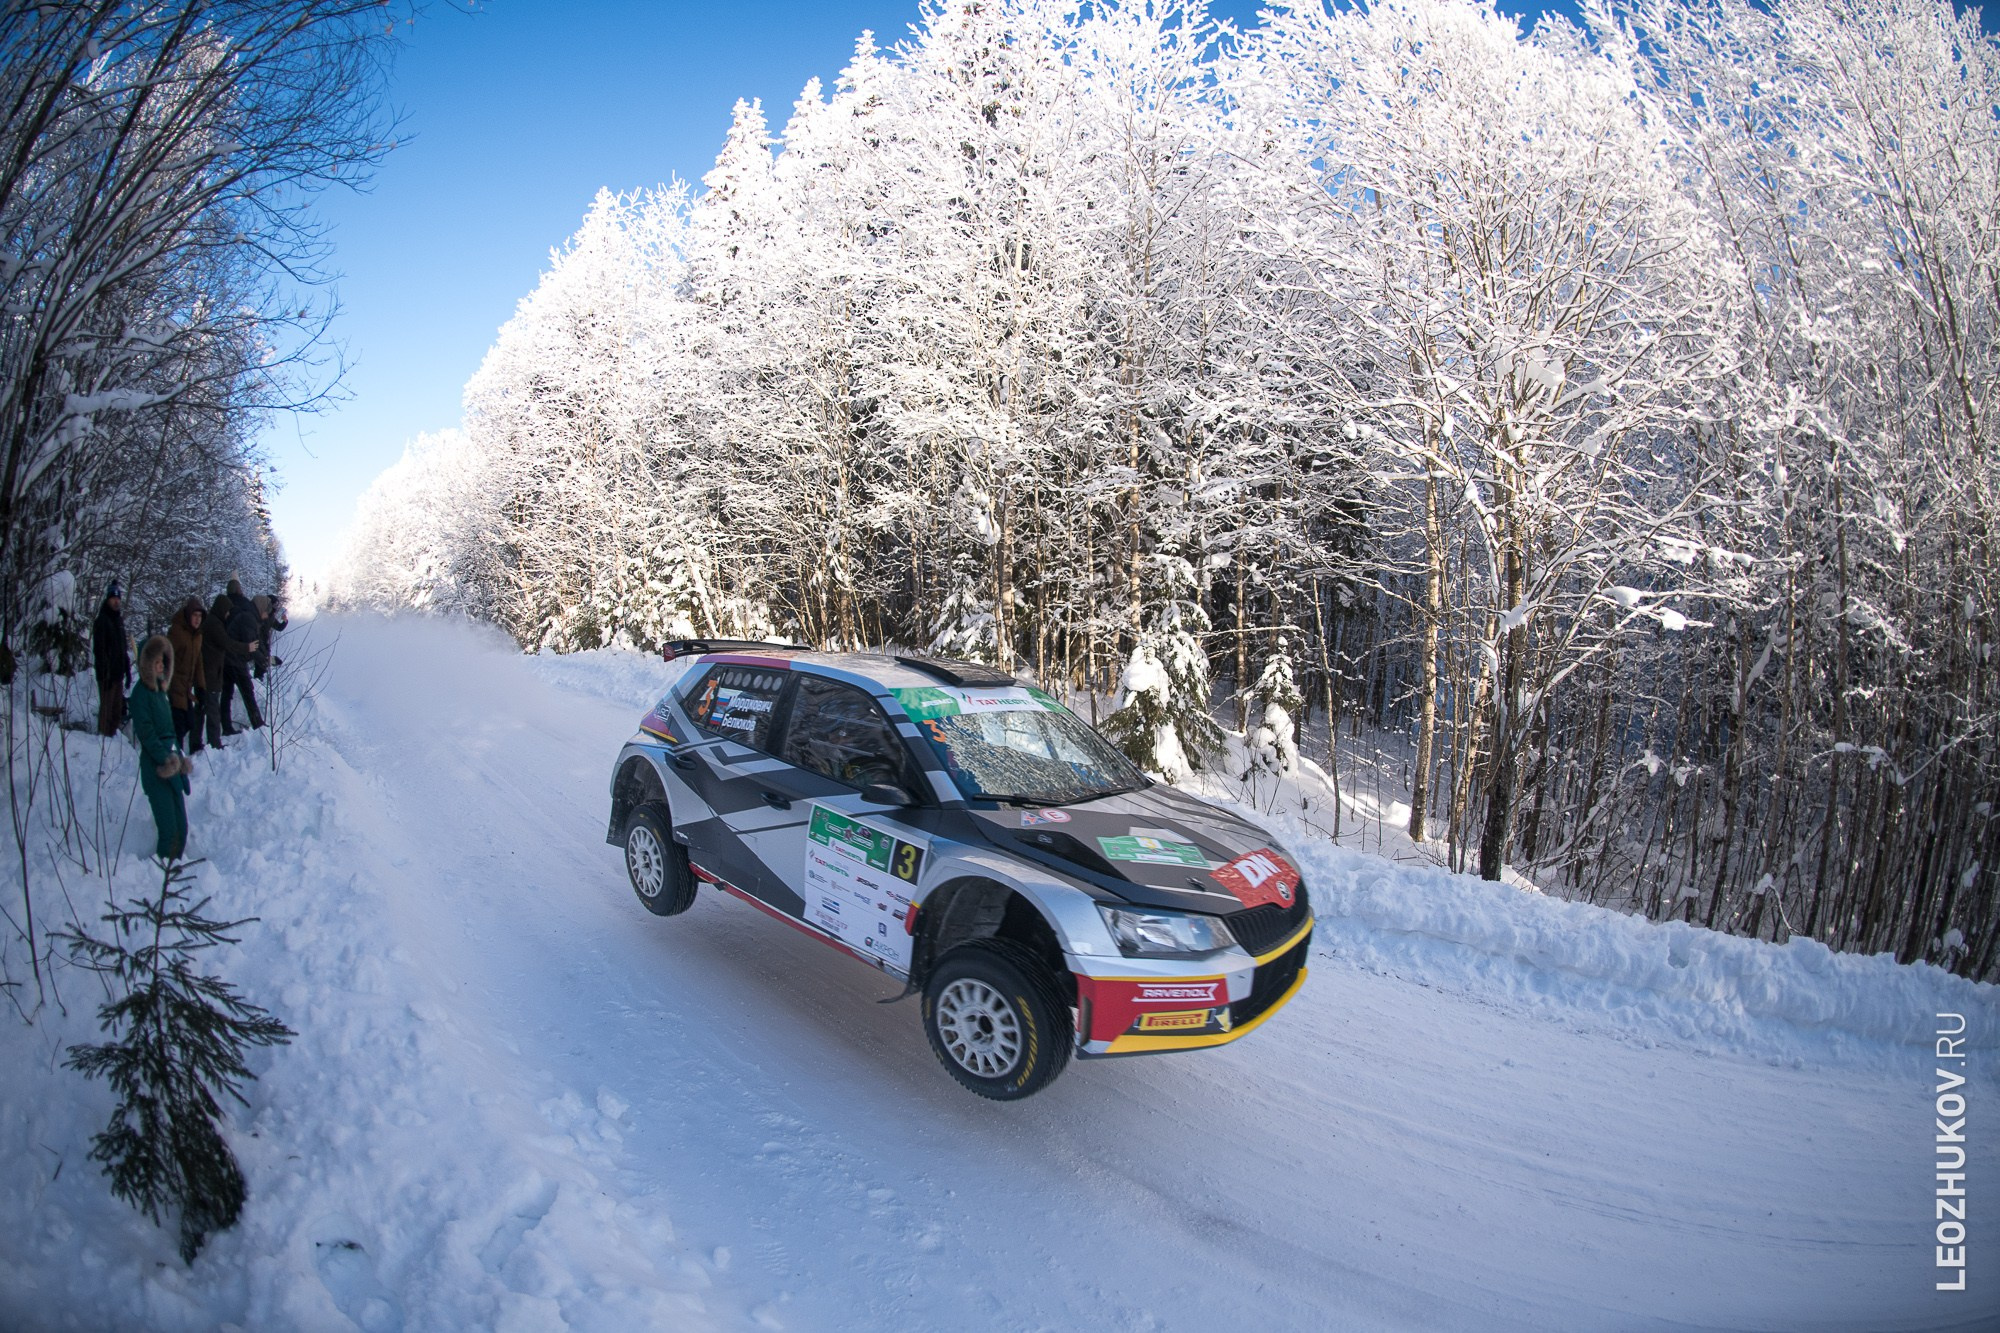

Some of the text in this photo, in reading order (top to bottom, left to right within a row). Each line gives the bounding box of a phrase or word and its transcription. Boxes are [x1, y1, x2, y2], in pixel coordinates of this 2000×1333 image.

[697, 679, 719, 716] 3
[728, 695, 773, 713] Мордкович
[721, 713, 756, 732] Белюков
[923, 719, 948, 743] 3
[897, 844, 917, 880] 3
[1142, 987, 1209, 998] RAVENOL
[1147, 1012, 1204, 1027] PIRELLI
